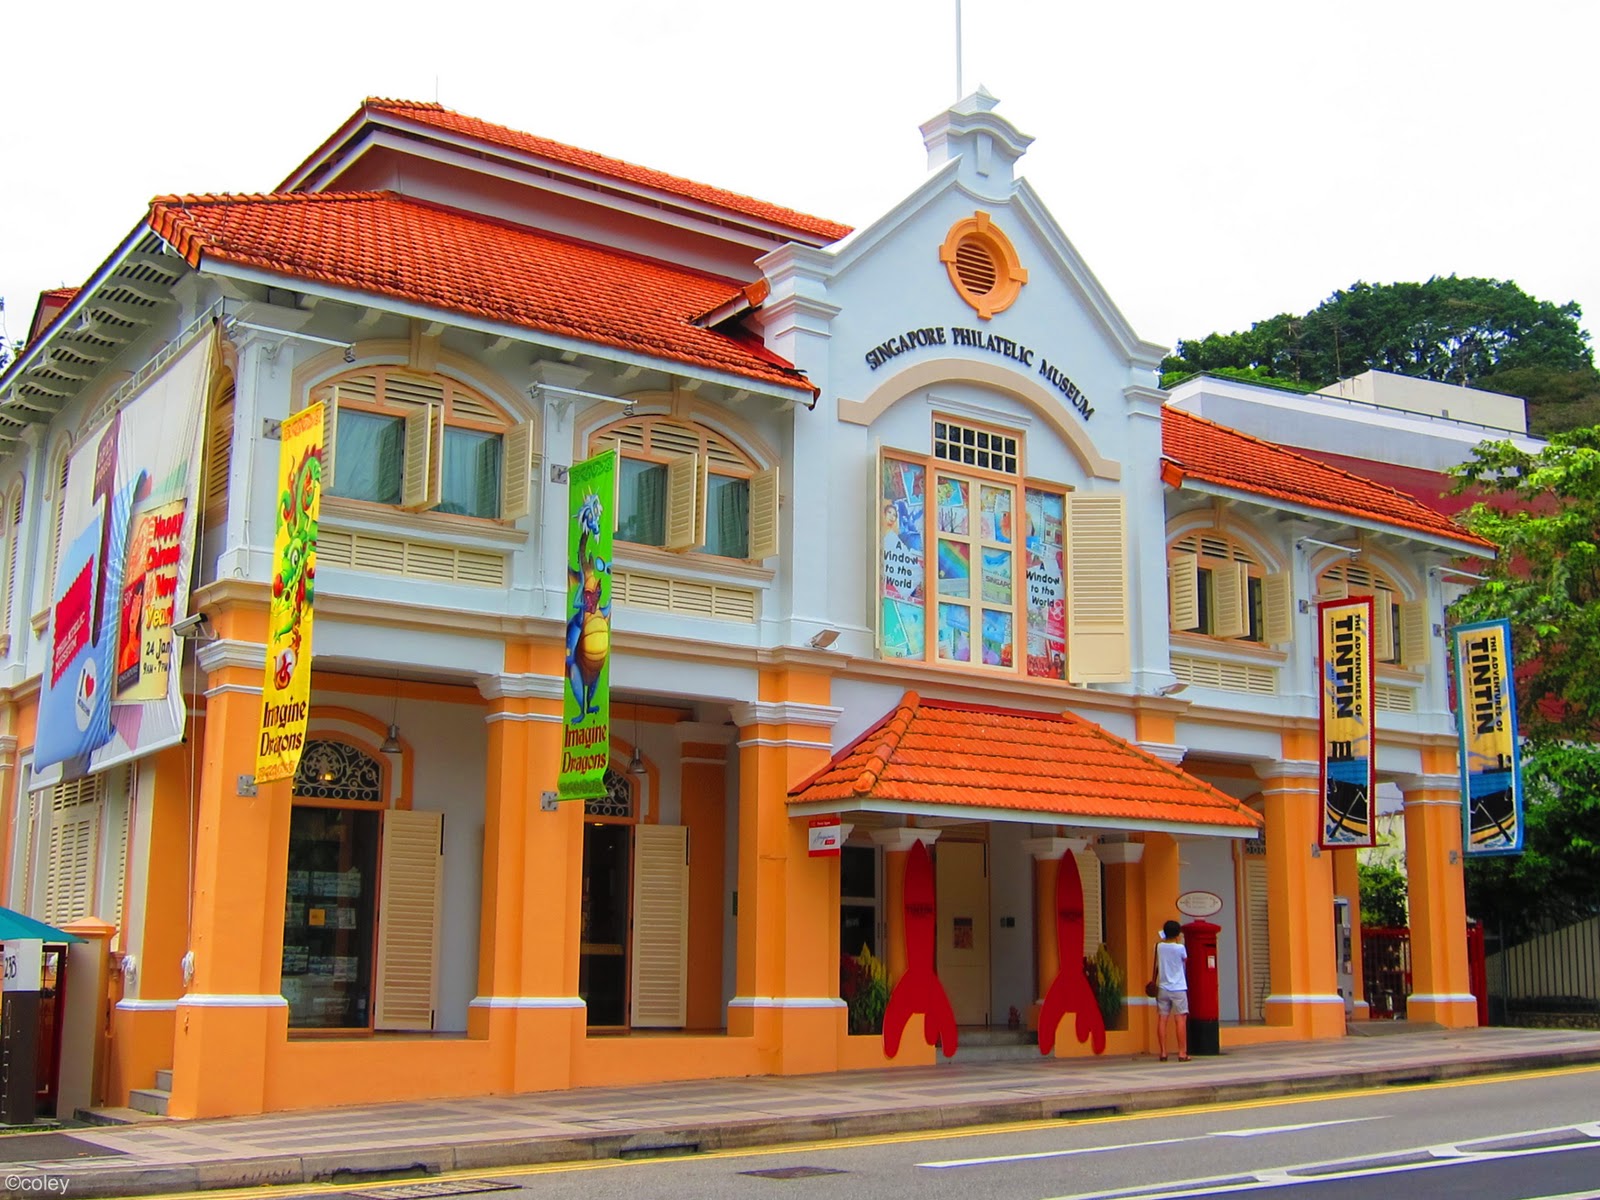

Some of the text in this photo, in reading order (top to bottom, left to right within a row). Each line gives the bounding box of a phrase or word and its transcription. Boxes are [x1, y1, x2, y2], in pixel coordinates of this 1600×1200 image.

[865, 327, 1095, 421] SINGAPORE PHILATELIC MUSEUM
[154, 511, 184, 542] Happy
[896, 541, 902, 550] A
[146, 544, 181, 572] Chinese
[885, 564, 912, 576] to the
[1039, 562, 1046, 572] A
[886, 576, 912, 588] World
[1026, 570, 1060, 585] Window
[156, 574, 177, 598] New
[1031, 585, 1055, 596] to the
[1031, 595, 1054, 608] World
[145, 641, 155, 656] 24
[1336, 615, 1353, 719] TINTIN
[1471, 637, 1494, 734] TINTIN
[1491, 656, 1502, 717] ADVENTURES
[1356, 704, 1362, 717] OF
[1496, 720, 1503, 732] OF
[565, 719, 607, 749] Imagine
[562, 751, 606, 775] Dragons
